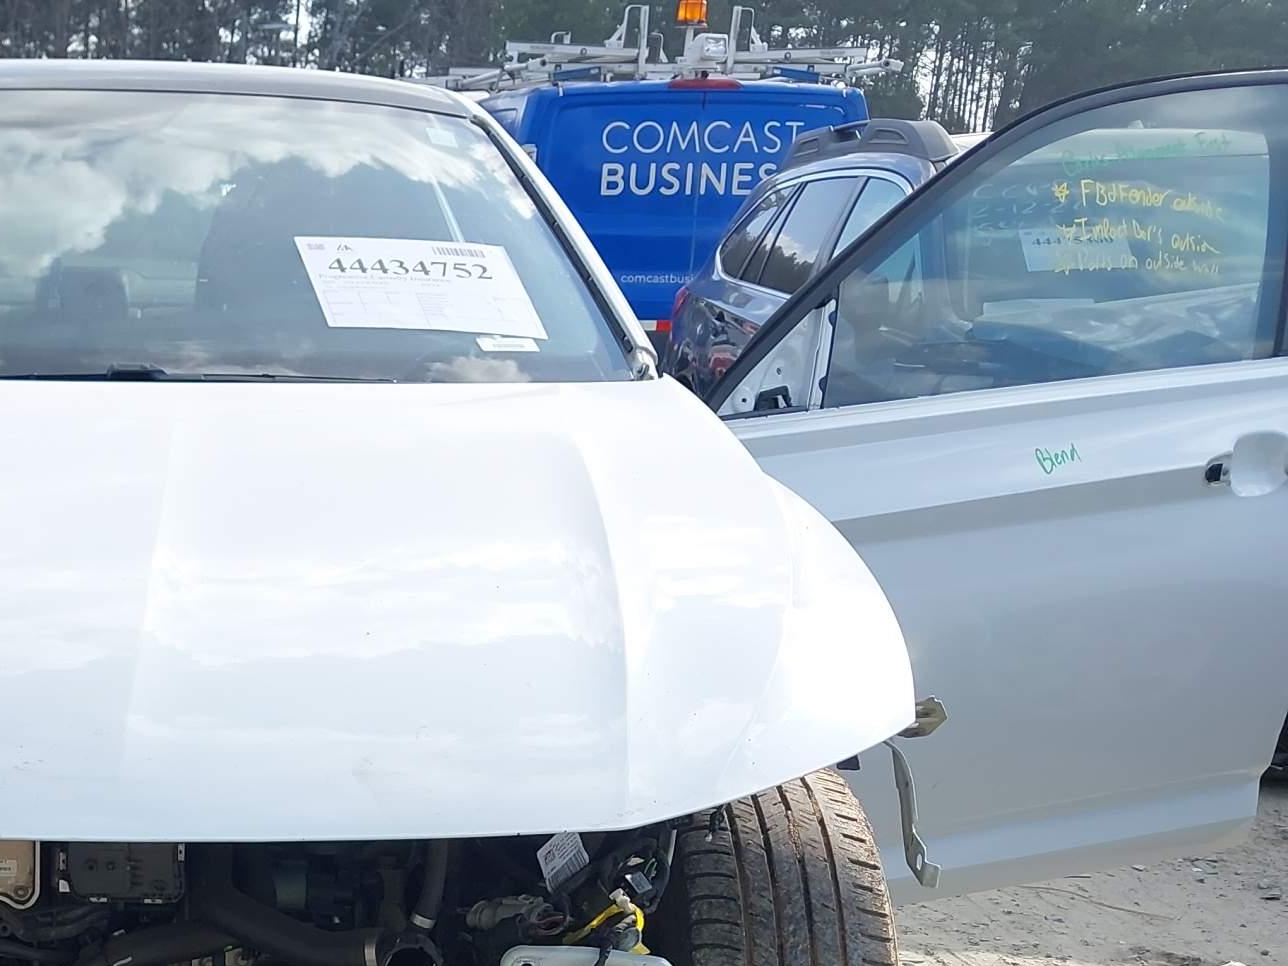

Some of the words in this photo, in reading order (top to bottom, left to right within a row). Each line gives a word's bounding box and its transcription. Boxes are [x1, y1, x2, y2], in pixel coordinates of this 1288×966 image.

[601, 120, 806, 154] COMCAST
[328, 257, 493, 281] 44434752
[1034, 441, 1082, 475] Blend
